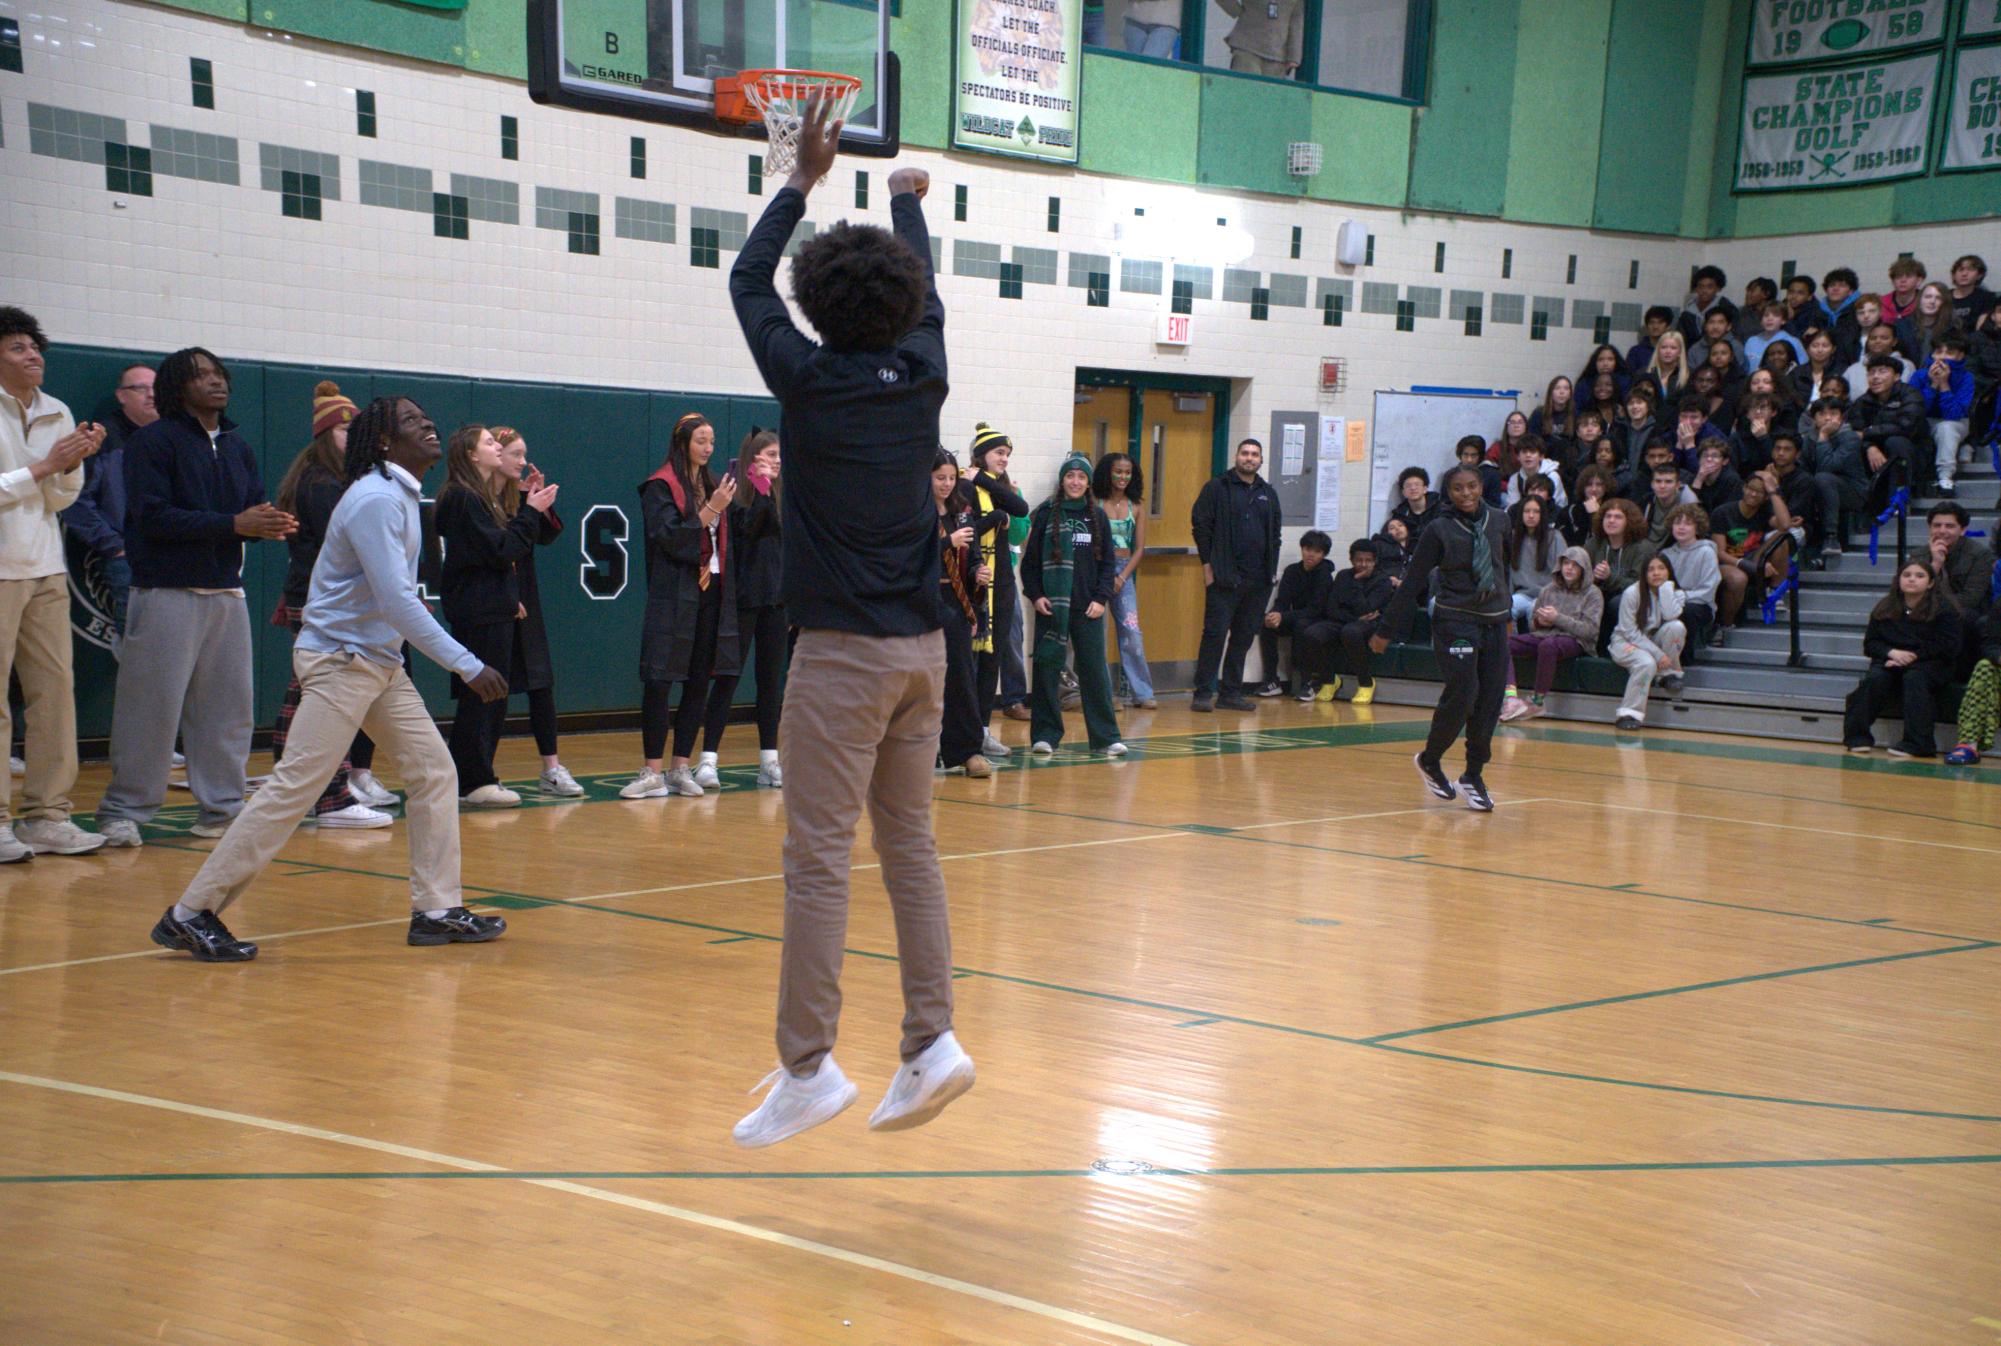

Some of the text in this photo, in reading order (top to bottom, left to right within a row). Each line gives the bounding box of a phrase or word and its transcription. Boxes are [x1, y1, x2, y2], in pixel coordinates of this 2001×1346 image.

[1002, 16, 1040, 34] LET THE
[1771, 0, 1928, 27] FOOTBA
[605, 31, 619, 54] B
[1774, 11, 1924, 56] 19 58
[971, 34, 1068, 64] OFFICIALS OFFICIATE.
[598, 68, 642, 84] GARED
[1001, 65, 1038, 82] LET THE
[1795, 68, 1885, 101] STATE
[961, 82, 1016, 103] SPECTATORS
[1020, 92, 1030, 105] BE
[1752, 87, 1923, 130] CHAMPIONS
[1795, 122, 1870, 151] GOLF
[1168, 317, 1189, 342] EXIT
